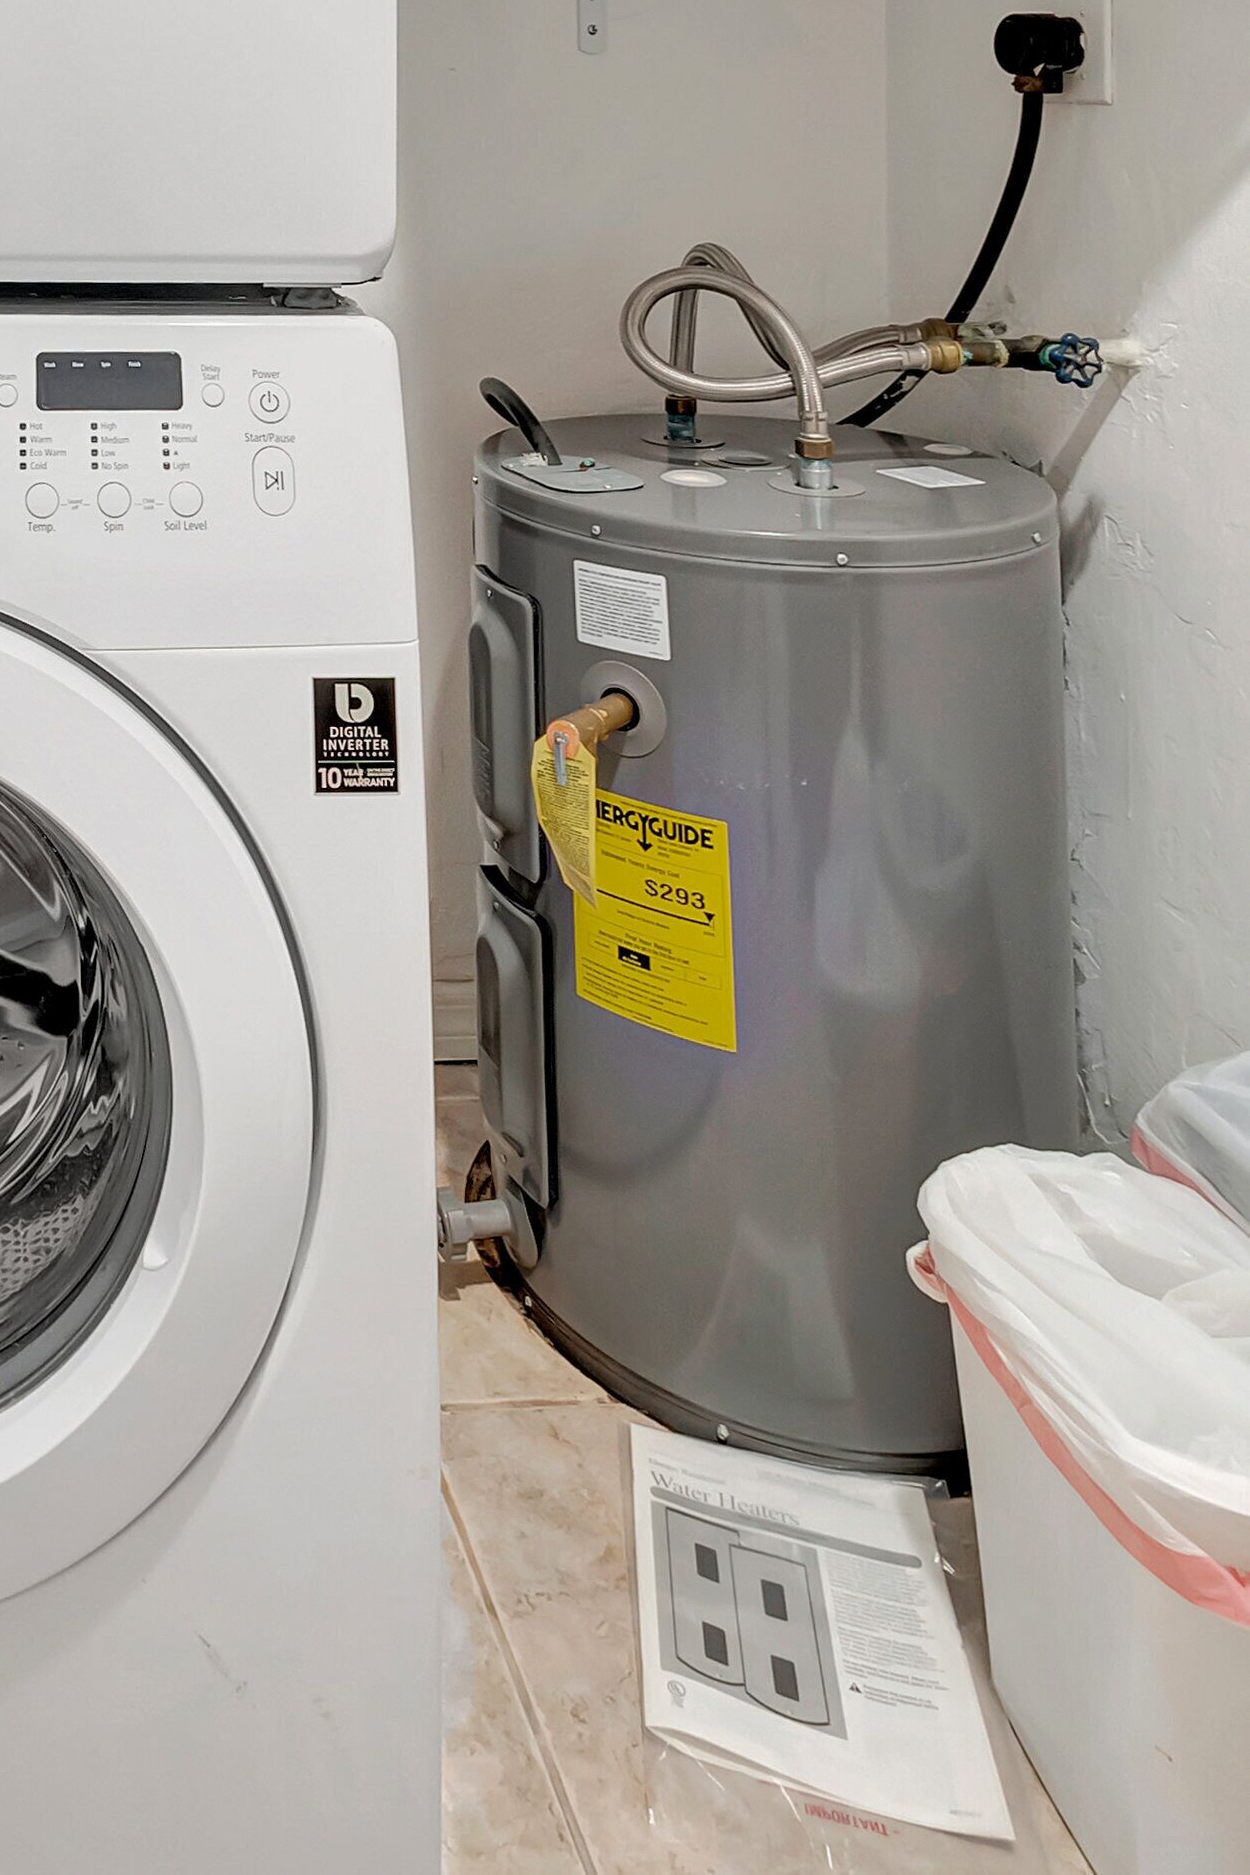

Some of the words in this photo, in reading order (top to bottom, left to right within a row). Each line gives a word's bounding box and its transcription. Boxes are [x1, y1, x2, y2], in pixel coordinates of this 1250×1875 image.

[252, 369, 280, 379] Power
[100, 422, 117, 432] High
[171, 422, 193, 432] Heavy
[30, 436, 53, 444] Warm
[100, 436, 130, 444] Medium
[171, 435, 198, 444] Normal
[244, 432, 296, 444] Start/Pause
[29, 449, 43, 457] Eco
[45, 449, 67, 457] Warm
[100, 449, 116, 457] Low
[30, 462, 48, 471] Cold
[101, 462, 112, 471] No
[113, 462, 129, 472] Spin
[172, 461, 190, 471] Light
[27, 522, 56, 533] Temp.
[104, 521, 125, 533] Spin
[164, 520, 182, 532] Soil
[183, 520, 208, 532] Level
[329, 726, 382, 738] DIGITAL
[322, 738, 389, 751] INVERTER
[317, 766, 342, 789] 10
[343, 768, 364, 777] YEAR
[343, 777, 396, 788] WARRANTY
[650, 1470, 711, 1503] Water
[718, 1492, 801, 1526] Heaters
